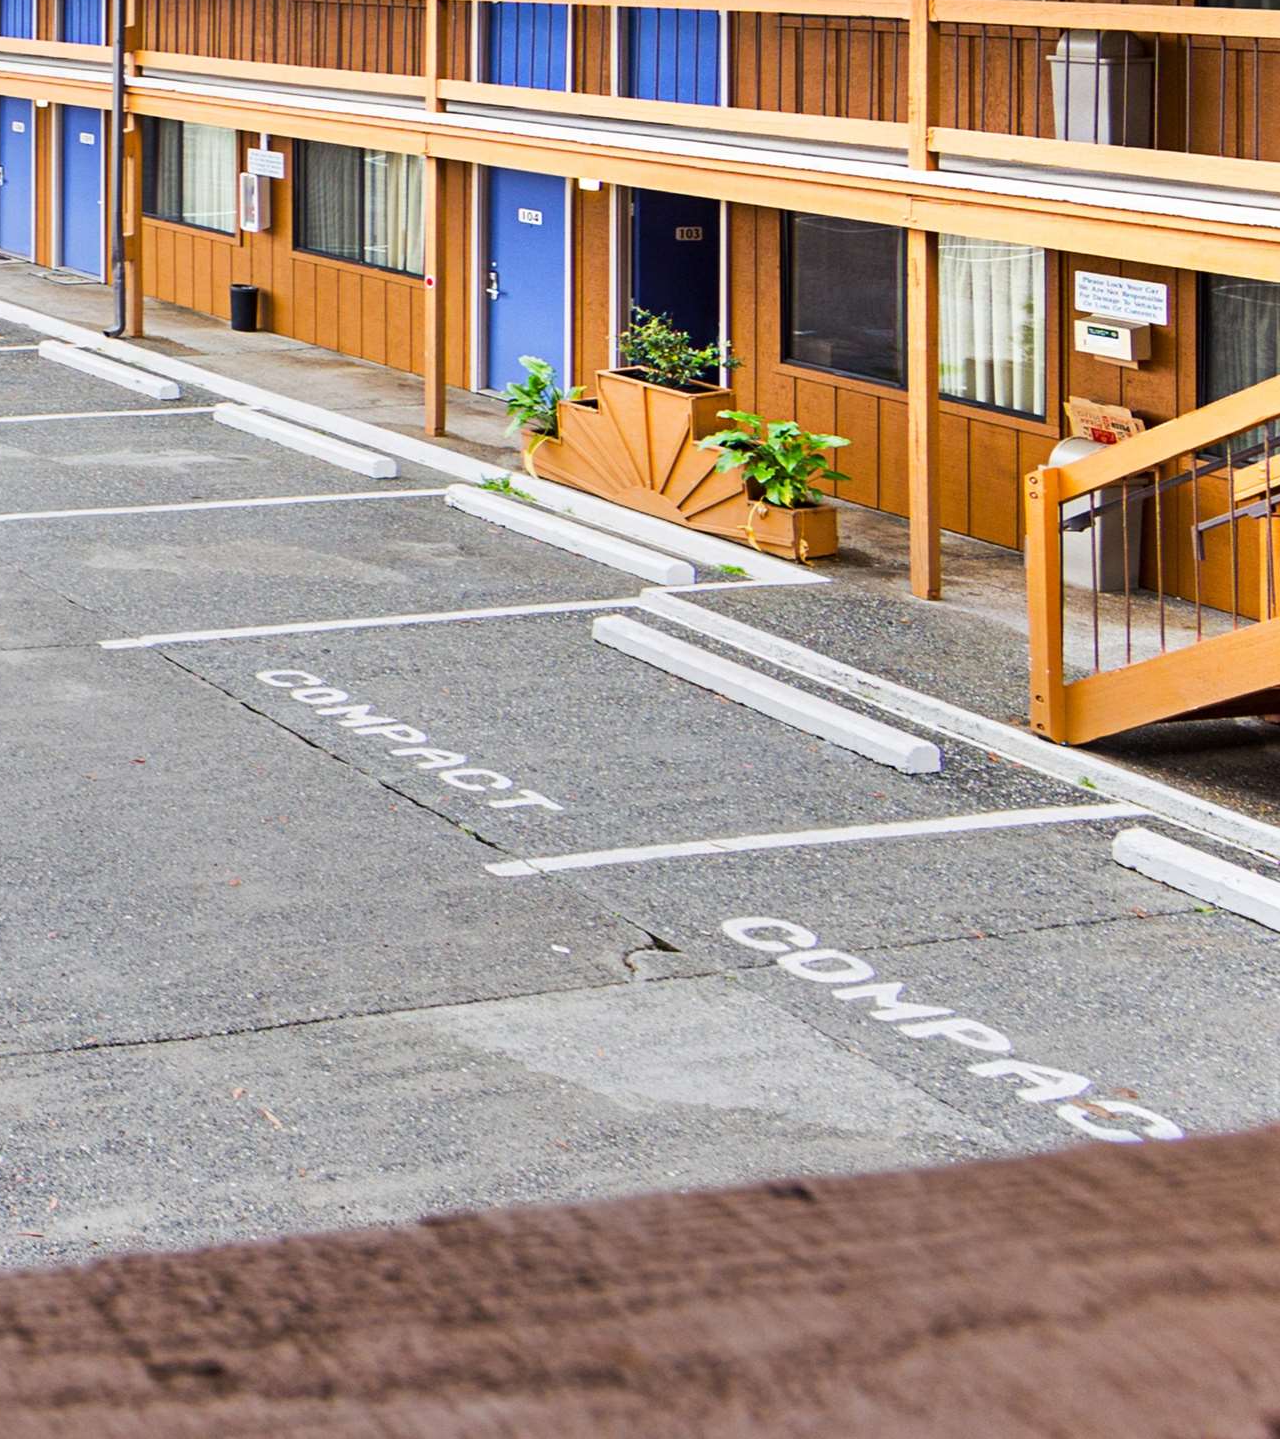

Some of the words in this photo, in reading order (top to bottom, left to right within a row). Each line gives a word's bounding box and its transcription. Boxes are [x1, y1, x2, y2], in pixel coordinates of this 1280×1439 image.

[522, 210, 540, 222] 104
[678, 228, 700, 240] 103
[1082, 276, 1104, 286] Please
[1106, 279, 1123, 289] Lock
[1127, 283, 1143, 292] Your
[1144, 286, 1159, 294] Car
[1092, 285, 1104, 293] Are
[255, 669, 565, 811] COMPACT
[720, 916, 1185, 1143] COMPAC
